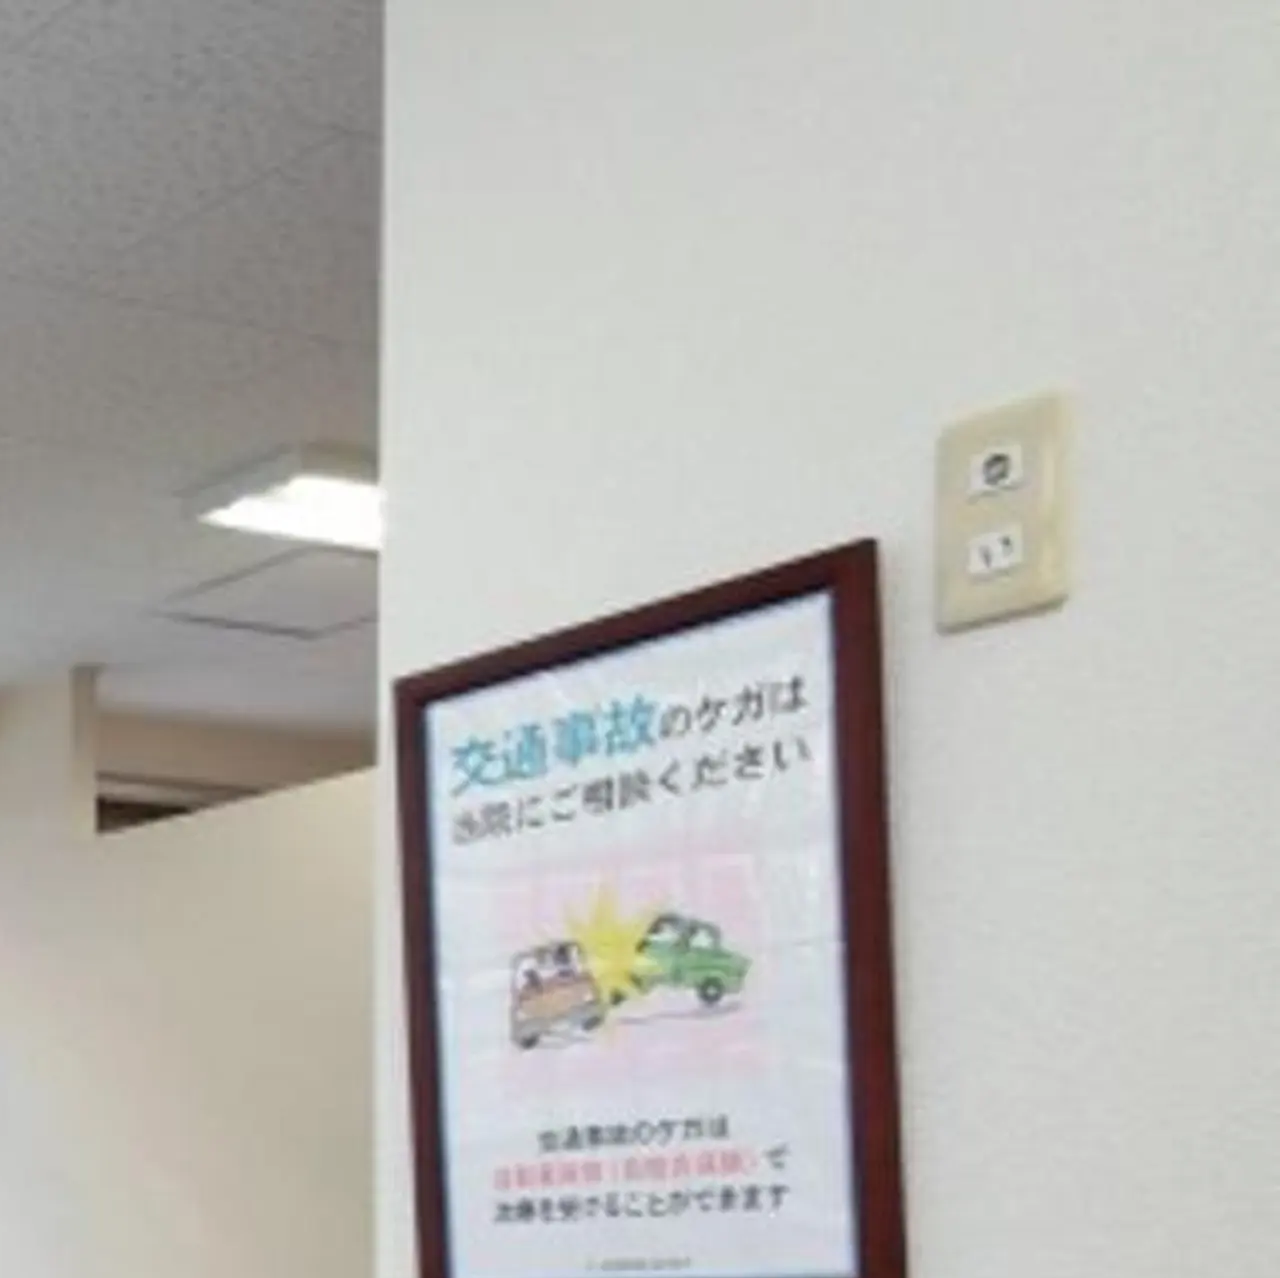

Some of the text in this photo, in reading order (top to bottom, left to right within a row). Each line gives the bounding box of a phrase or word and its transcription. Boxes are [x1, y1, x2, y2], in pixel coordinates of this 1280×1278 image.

[451, 674, 810, 796] 交通事故のケガは
